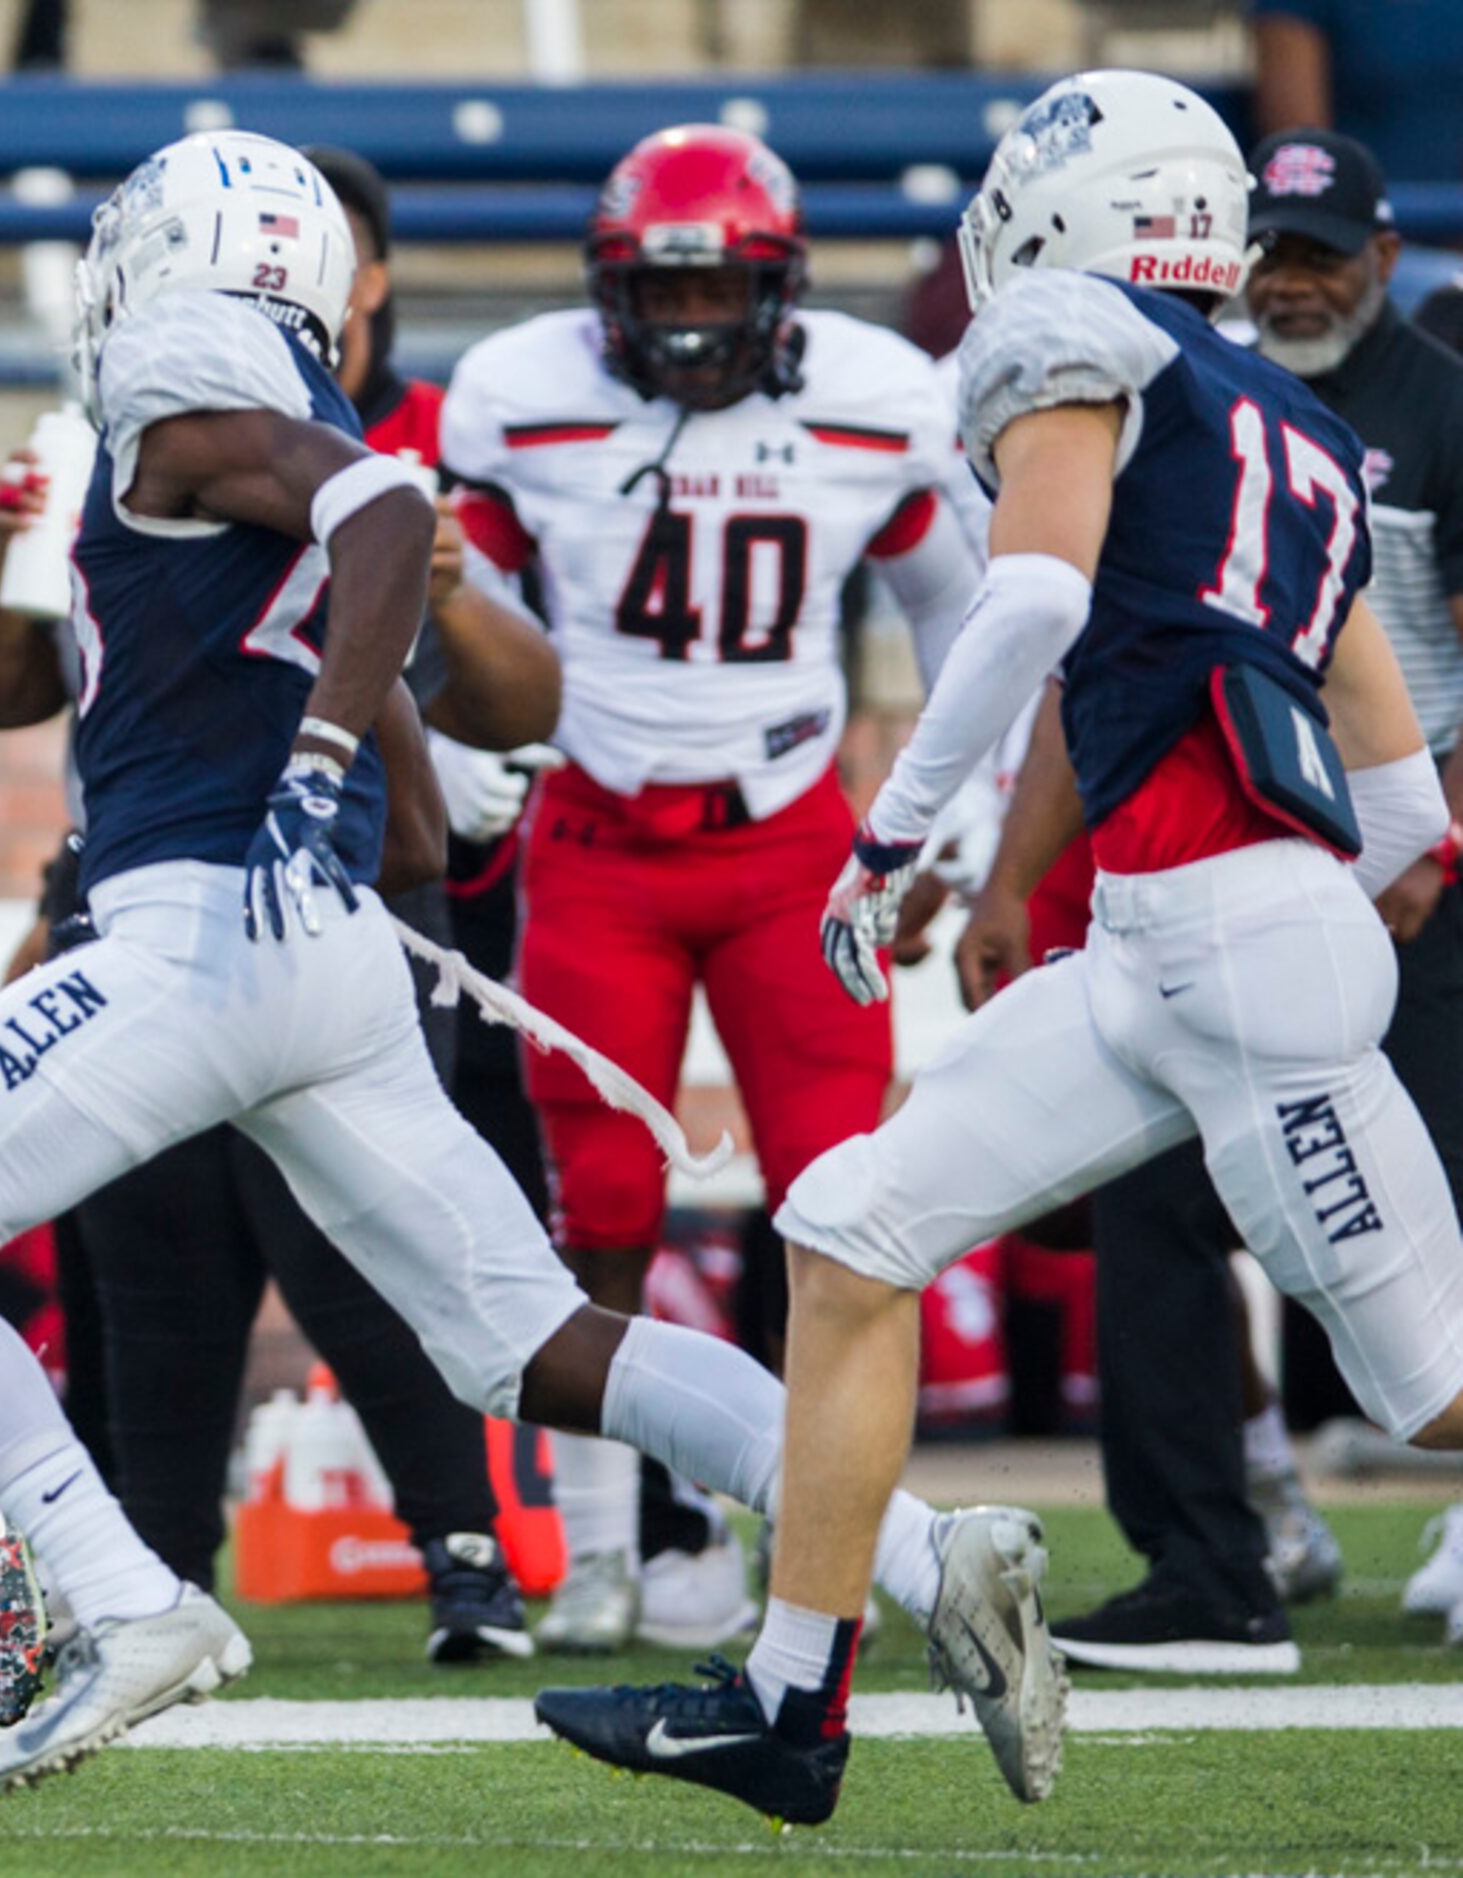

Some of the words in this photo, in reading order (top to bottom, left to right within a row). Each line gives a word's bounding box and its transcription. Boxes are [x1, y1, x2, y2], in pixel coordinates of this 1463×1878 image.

[1130, 255, 1240, 289] Riddell
[1190, 214, 1212, 239] 17
[252, 262, 288, 291] 23
[1198, 394, 1360, 671] 17
[614, 508, 809, 663] 40
[1276, 1093, 1384, 1245] ALLEN
